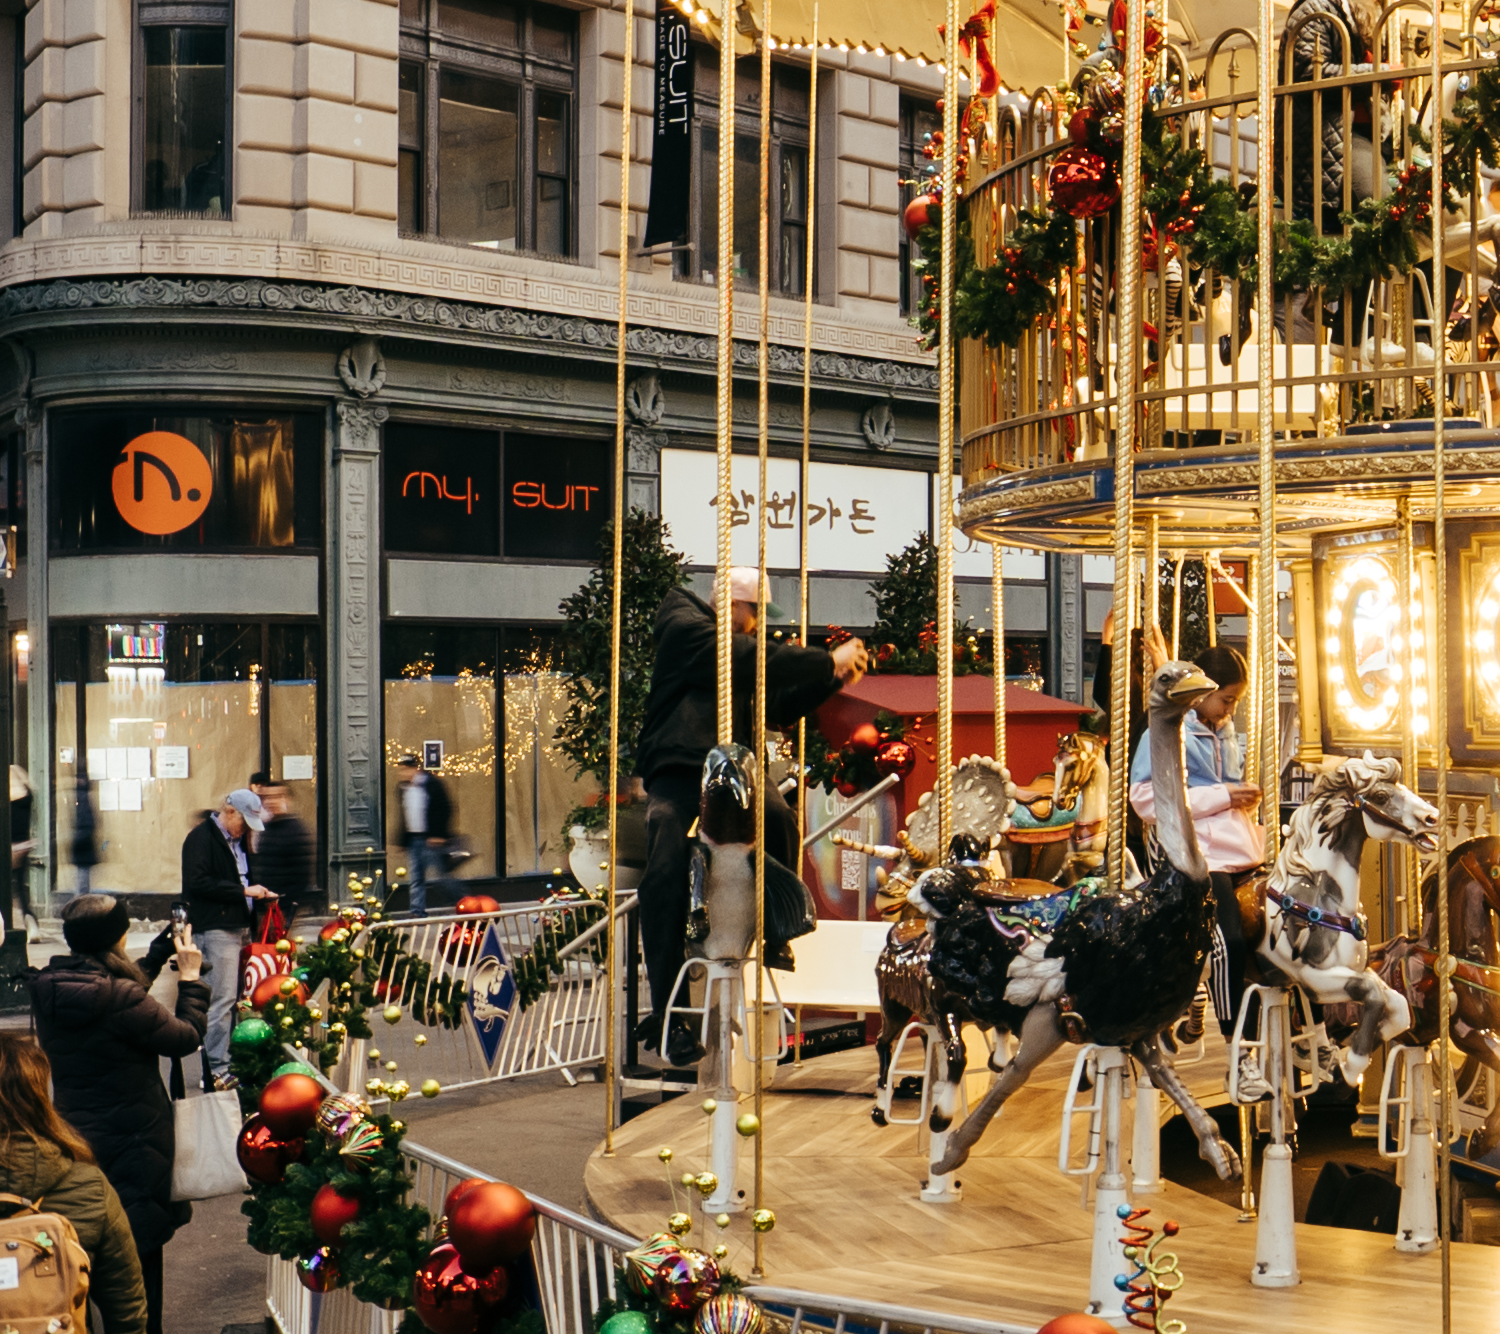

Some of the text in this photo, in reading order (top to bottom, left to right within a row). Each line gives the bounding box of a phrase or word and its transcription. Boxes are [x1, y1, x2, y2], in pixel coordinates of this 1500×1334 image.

[657, 16, 667, 137] MADE TO MEASURE
[512, 481, 599, 512] SUIT
